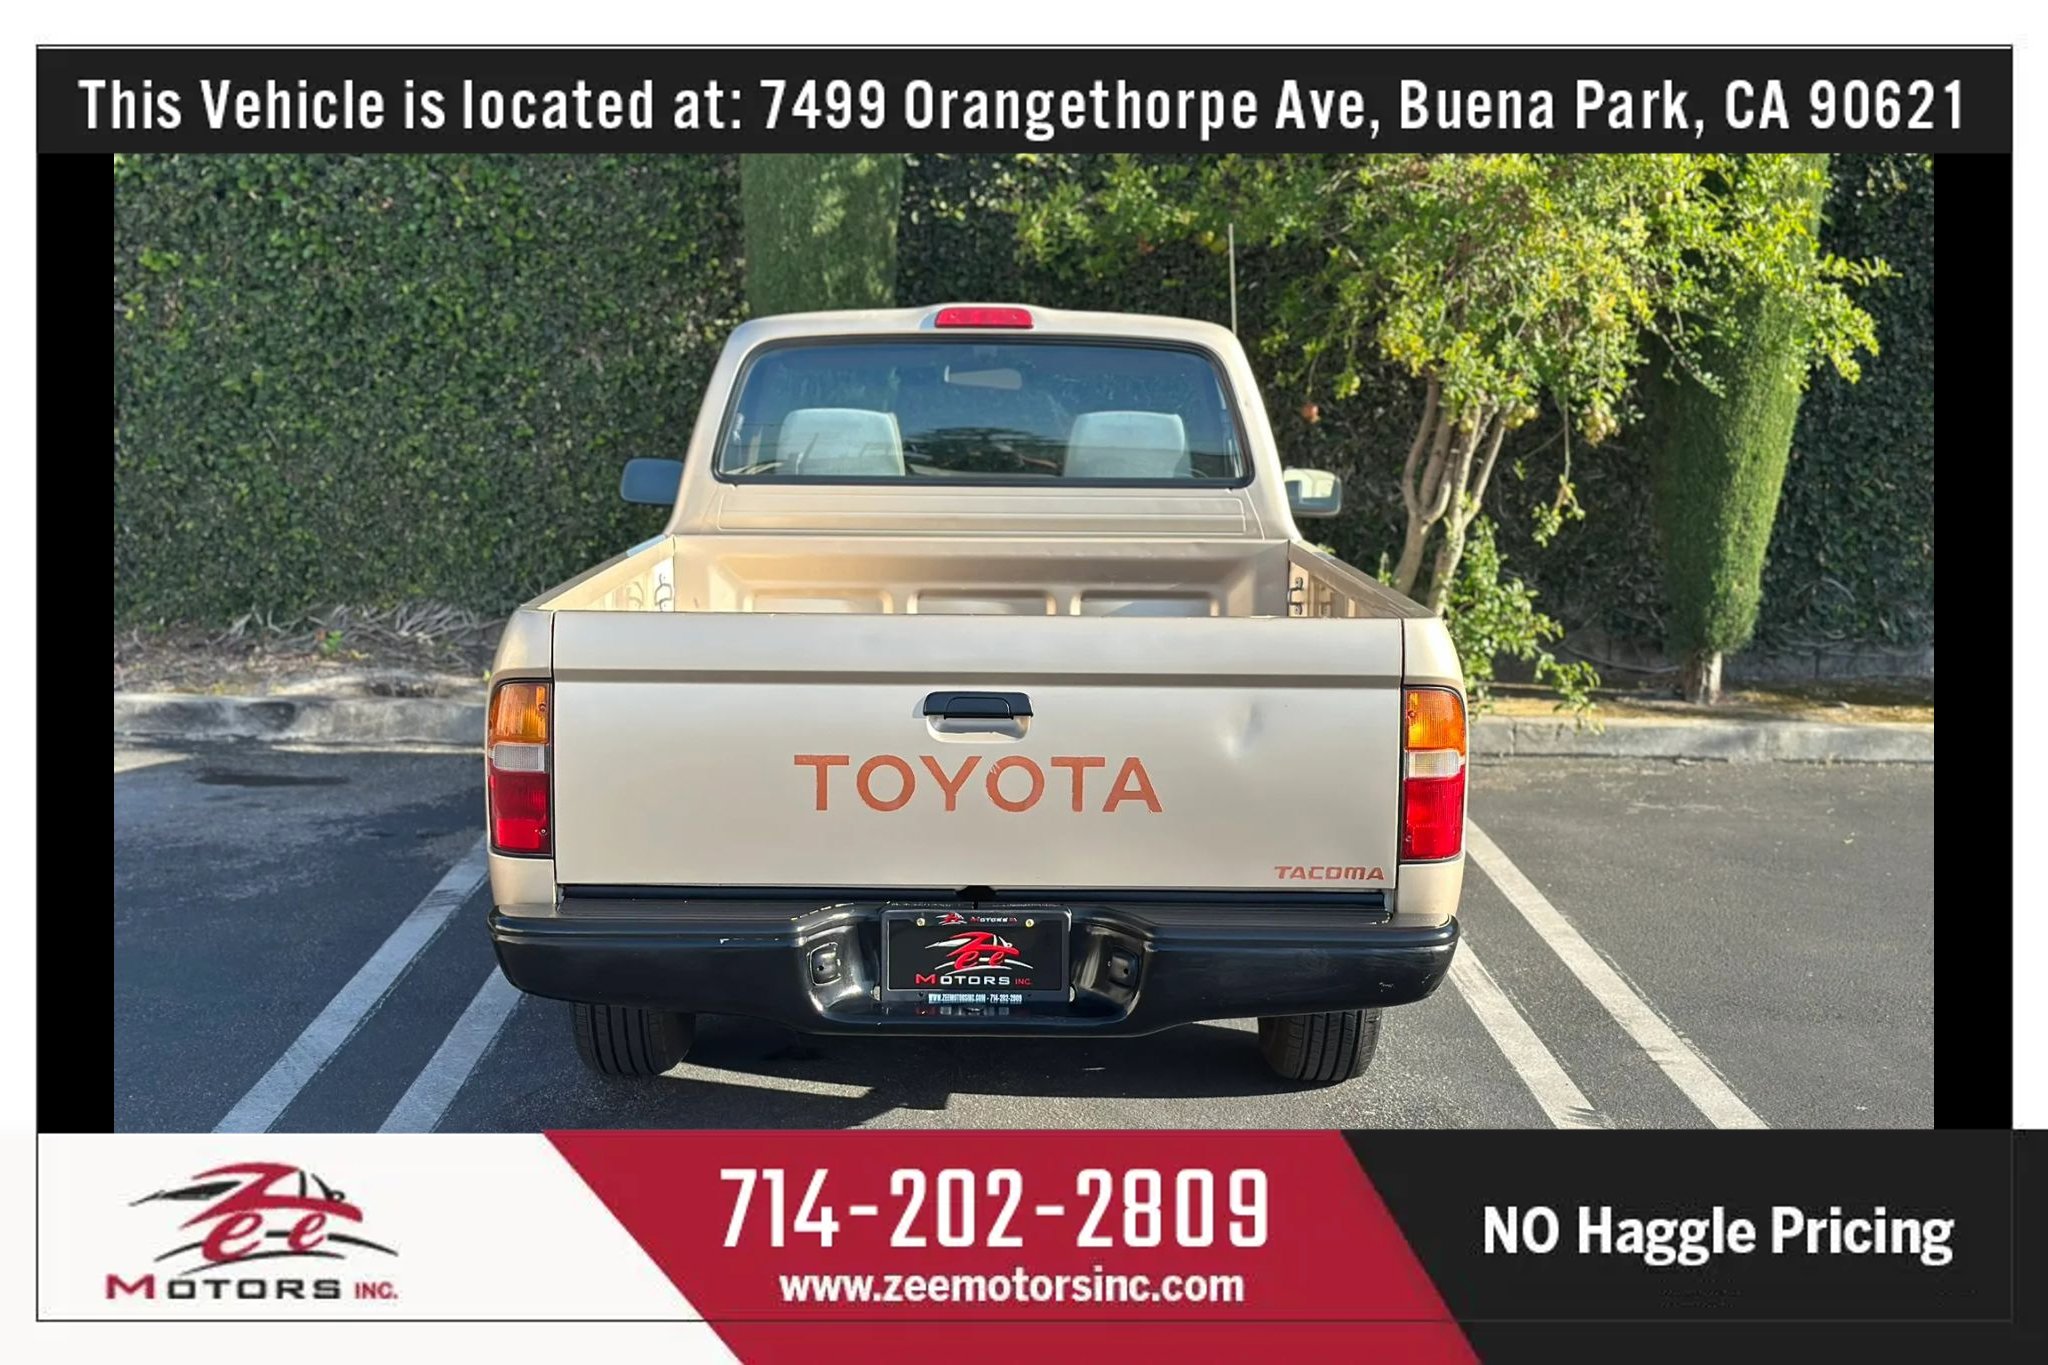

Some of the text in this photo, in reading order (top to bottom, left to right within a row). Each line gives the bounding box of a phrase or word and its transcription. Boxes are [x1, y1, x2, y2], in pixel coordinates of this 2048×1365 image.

[794, 754, 1162, 813] TOYOTA
[1275, 865, 1384, 882] TACOMA
[914, 973, 1010, 986] MOTORS
